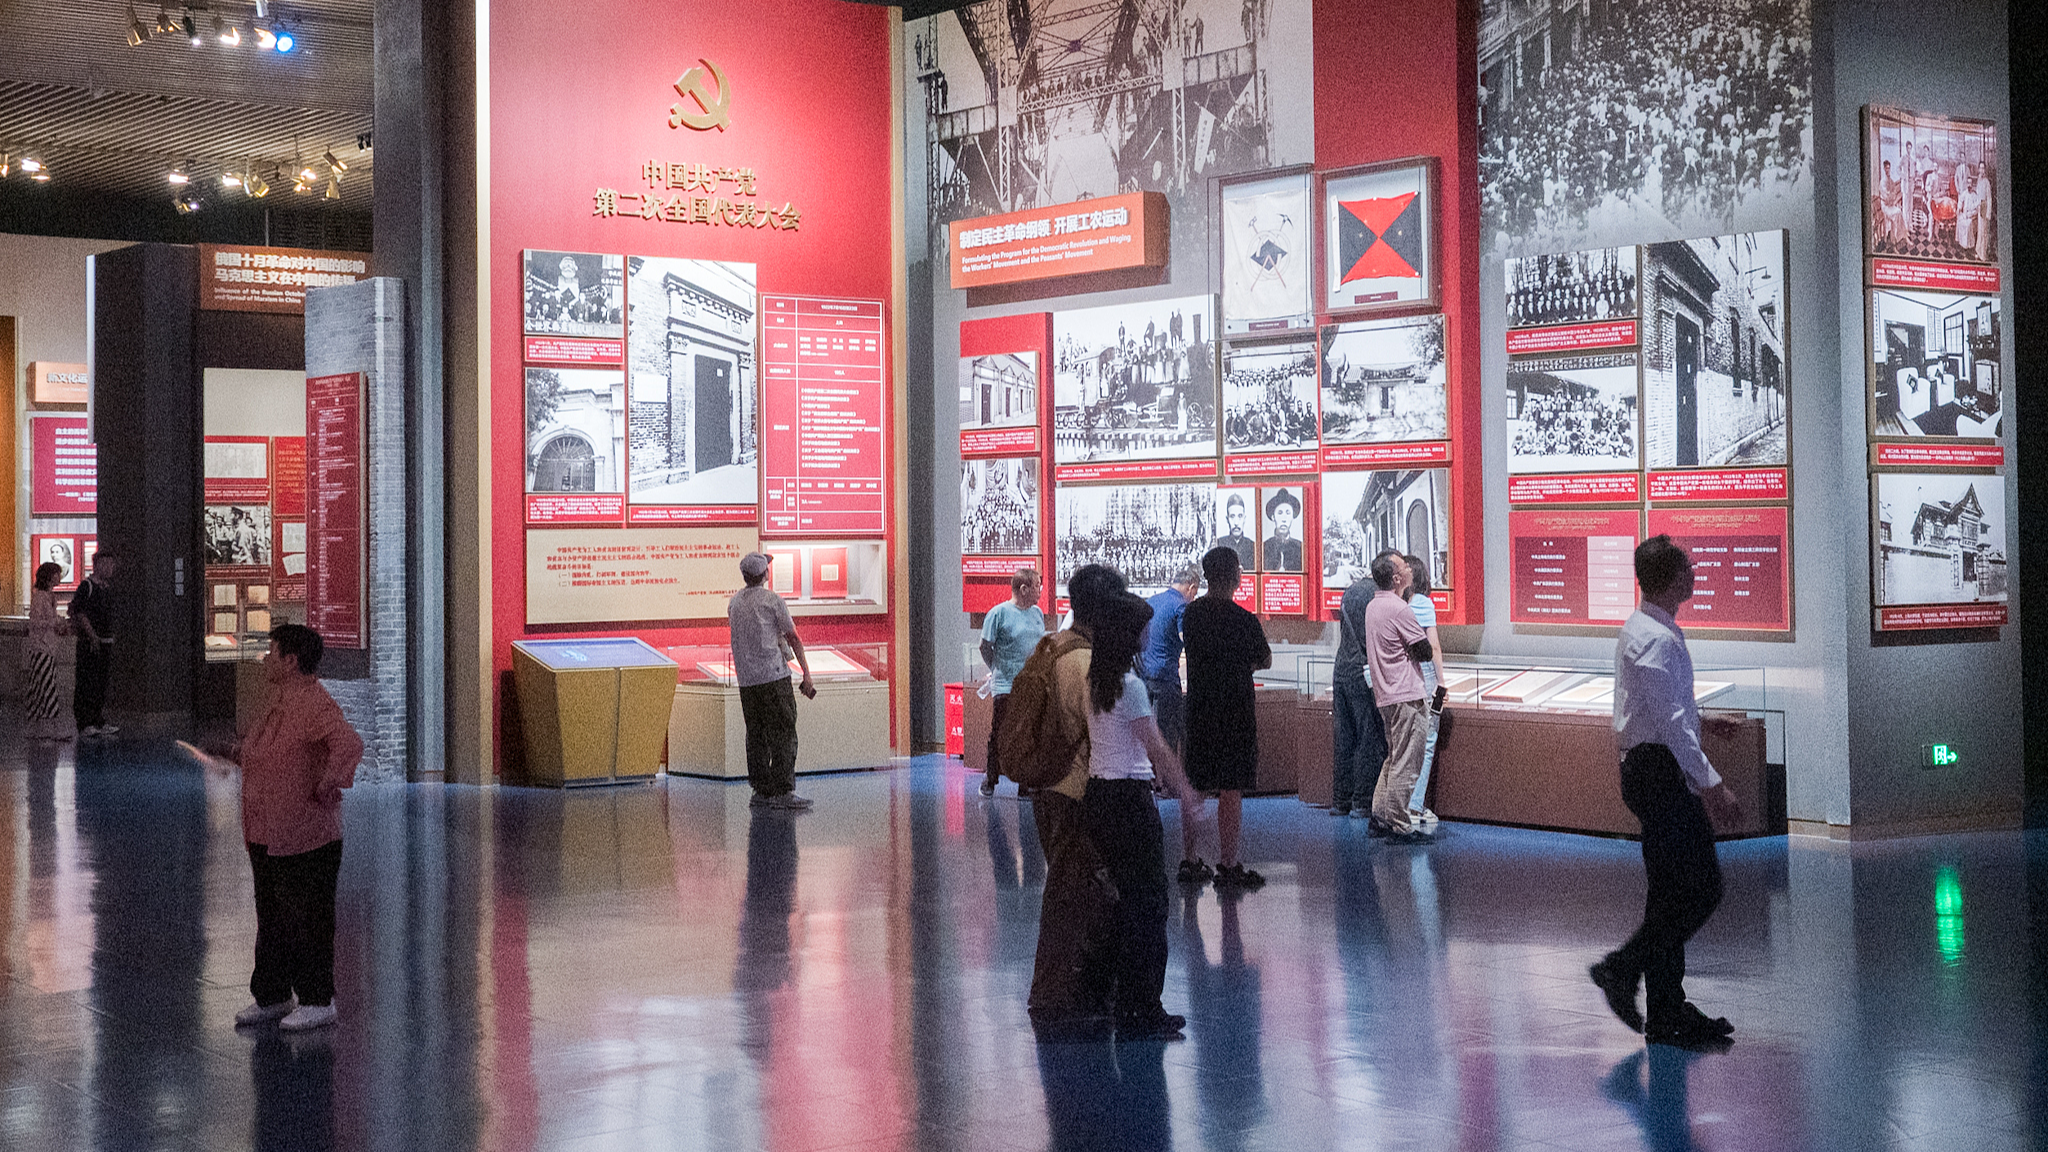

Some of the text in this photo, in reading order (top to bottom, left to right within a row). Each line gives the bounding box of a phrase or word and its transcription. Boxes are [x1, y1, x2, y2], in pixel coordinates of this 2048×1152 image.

[643, 159, 757, 196] 中国共产党
[593, 187, 802, 231] 第二次全国代表大会
[959, 206, 1128, 250] 制定民主革命纲领 开展工农运动
[215, 251, 366, 274] 俄国十月革命对中国的影响
[962, 234, 1131, 264] Formulating the Program for the Democratic Revolution and Waging
[993, 259, 1020, 268] Movement
[1020, 256, 1030, 264] and
[1031, 255, 1039, 263] the
[1064, 248, 1093, 258] Movement
